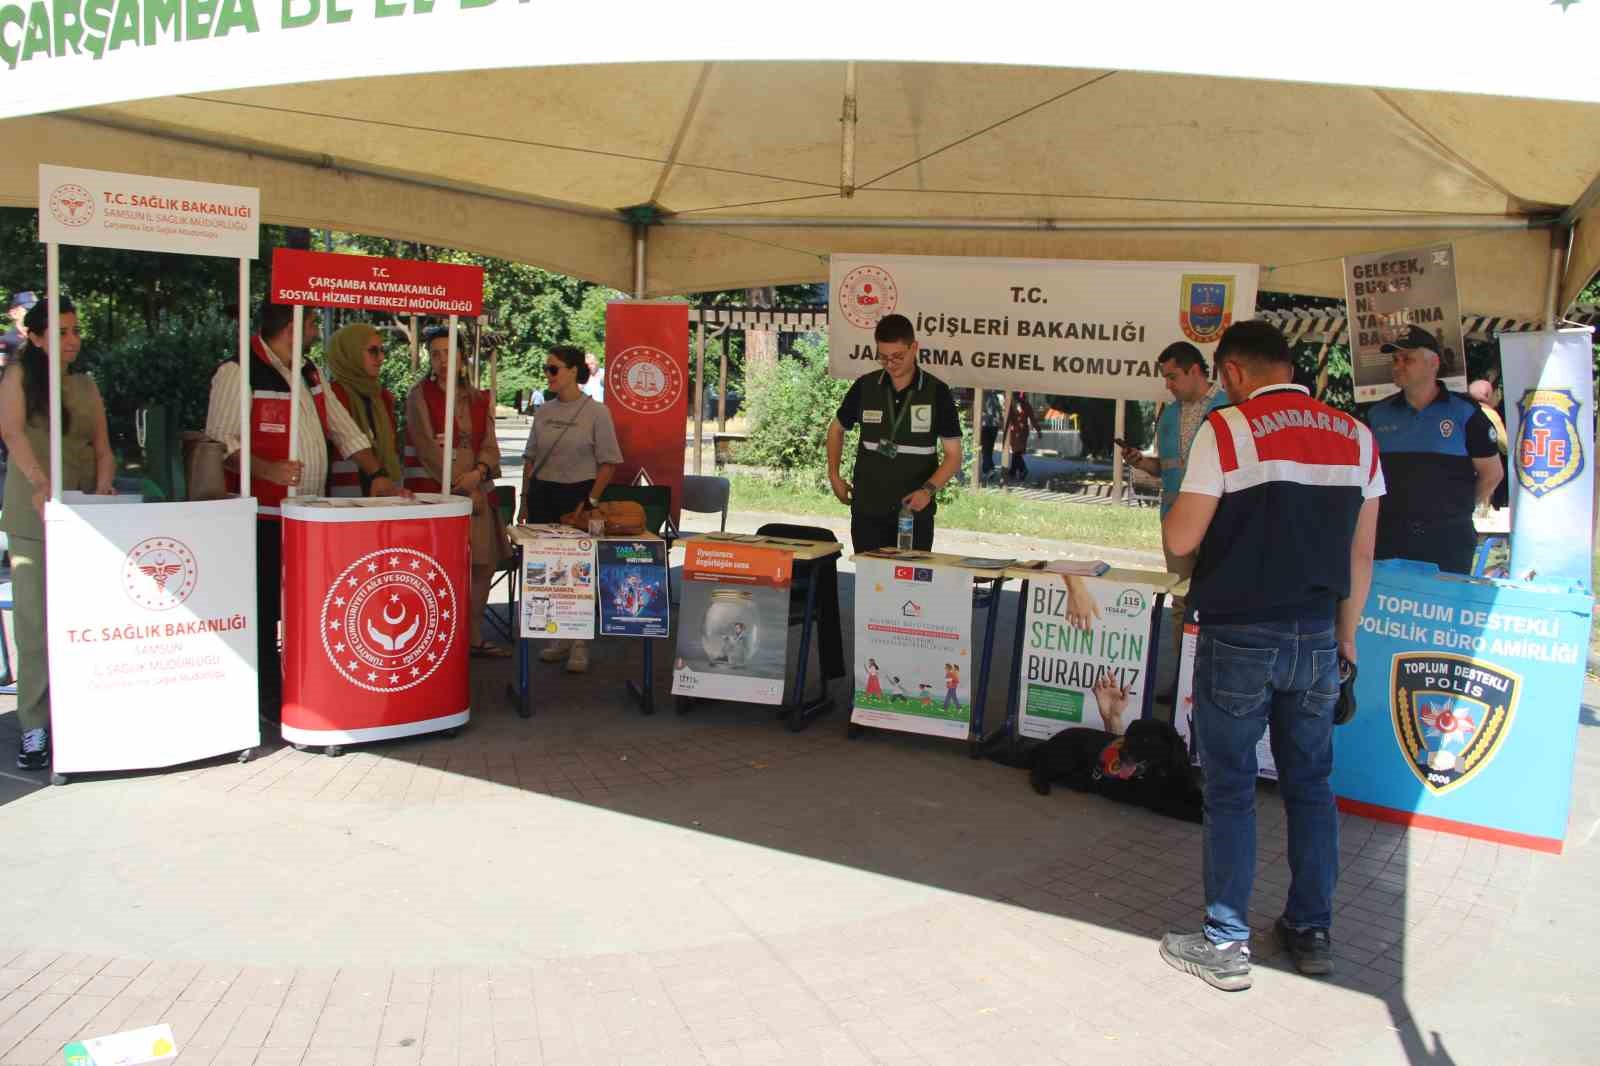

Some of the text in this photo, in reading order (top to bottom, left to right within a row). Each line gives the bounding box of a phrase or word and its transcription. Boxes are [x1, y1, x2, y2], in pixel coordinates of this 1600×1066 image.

[103, 192, 252, 218] T.C. SAĞLIK BAKANLIĞI
[308, 276, 446, 297] ÇARŞAMBA KAYMAKAMLIĞI
[371, 267, 390, 278] T.C.
[279, 289, 473, 312] SOSYAL HİZMET MERKEZİ MÜDÜRLÜĞÜ
[1010, 287, 1048, 304] T.C.
[915, 312, 1146, 342] İÇİŞLERİ BAKANLIĞI
[849, 344, 963, 367] JARMA
[970, 351, 1045, 372] GENEL
[1252, 410, 1360, 441] JANDARMA
[1033, 583, 1066, 617] BİZ
[1124, 596, 1140, 606] 115
[66, 614, 247, 643] T.C. SAĞLIK BAKANLIĞI
[1377, 594, 1560, 641] TOPLUM DESTEKLİ
[1100, 625, 1144, 663] İÇİN
[1433, 624, 1489, 652] BÜRO
[1490, 637, 1578, 664] AMİRLİĞİ
[1404, 662, 1448, 675] TOPLUM
